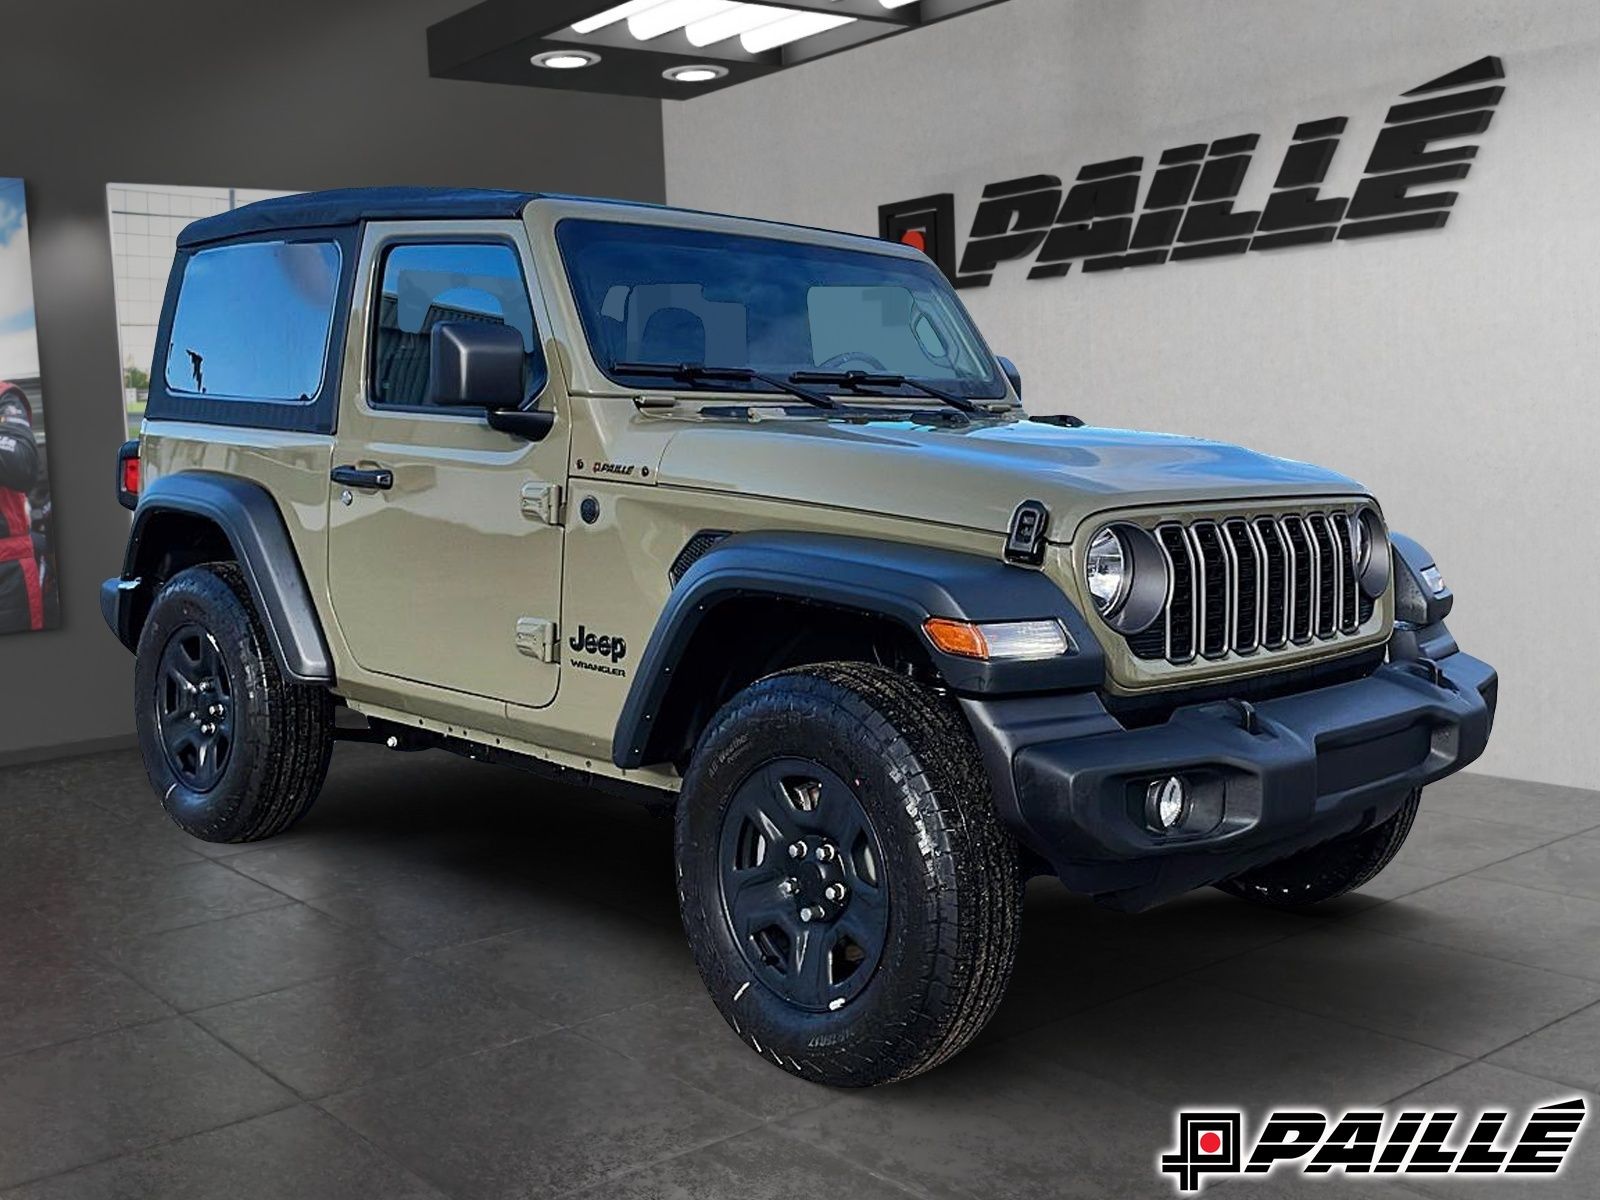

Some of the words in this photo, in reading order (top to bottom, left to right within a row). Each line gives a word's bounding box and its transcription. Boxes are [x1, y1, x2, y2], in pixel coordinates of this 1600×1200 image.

[957, 55, 1506, 288] PAILLÉ
[569, 624, 627, 663] Jeep
[570, 659, 626, 678] WRANGLER
